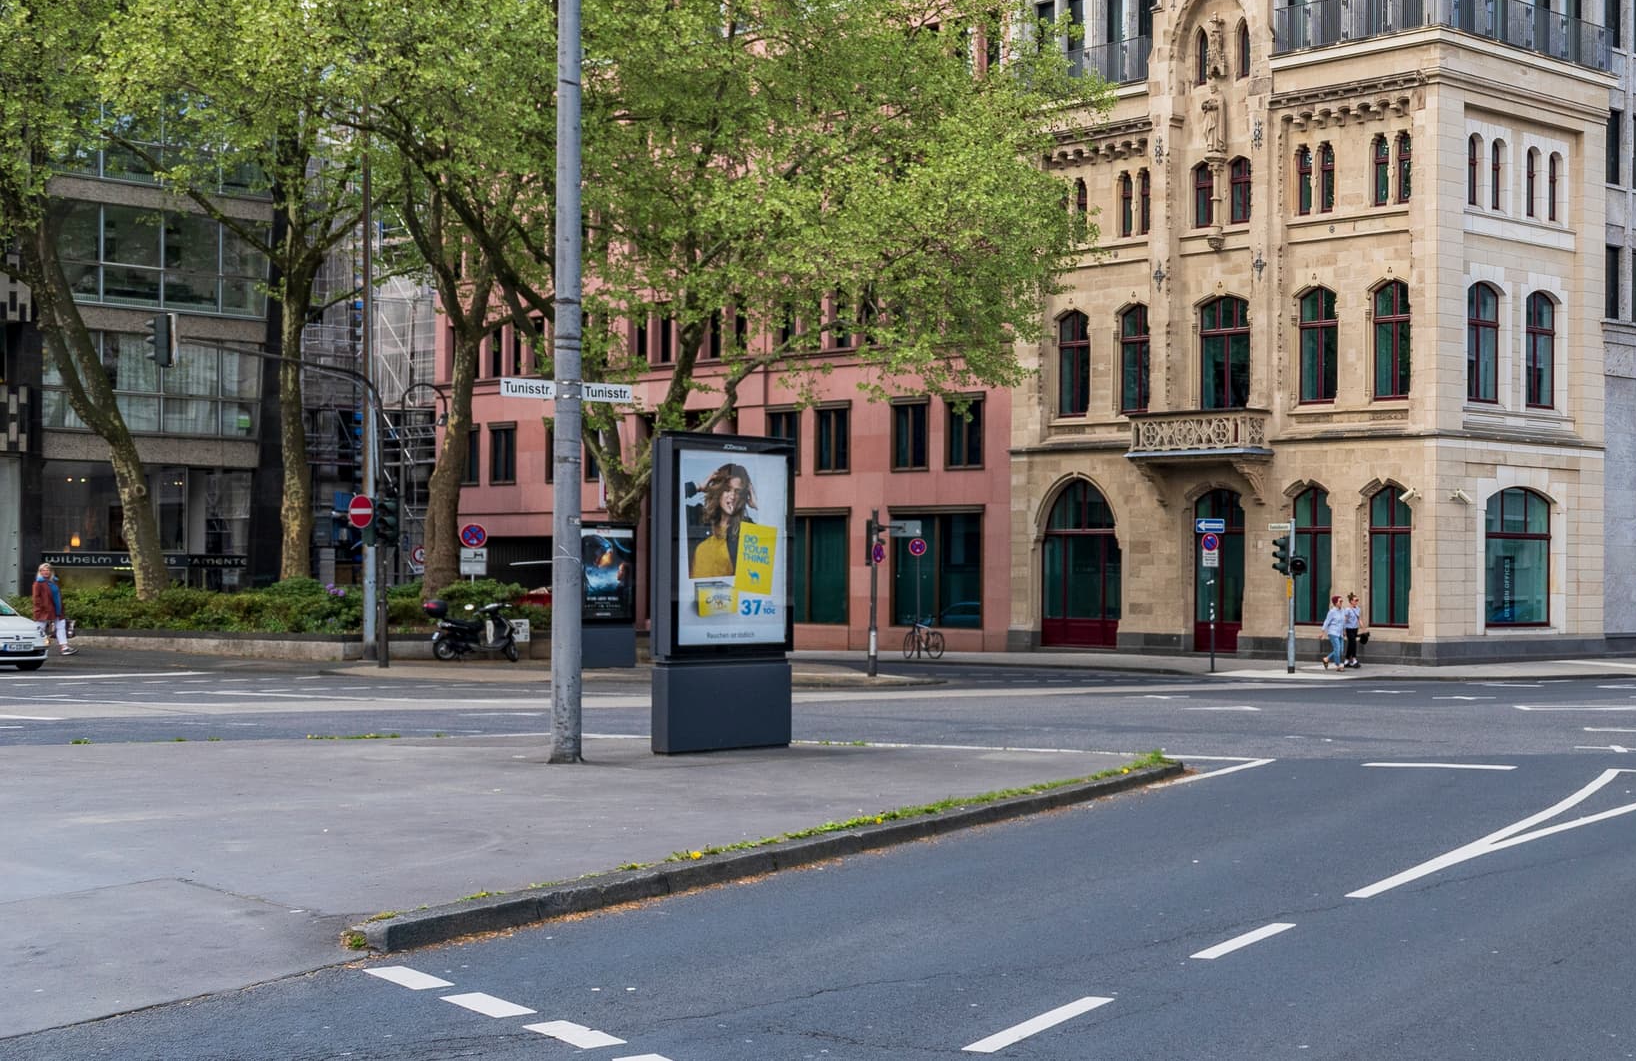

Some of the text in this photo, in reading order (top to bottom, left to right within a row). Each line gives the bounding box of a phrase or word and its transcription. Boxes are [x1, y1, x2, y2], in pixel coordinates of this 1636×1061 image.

[503, 381, 552, 395] Tunisstr.
[584, 386, 630, 399] Tunisstr.
[744, 534, 758, 544] DO
[743, 544, 769, 554] YOUR
[743, 552, 770, 565] THING
[741, 599, 762, 615] 37
